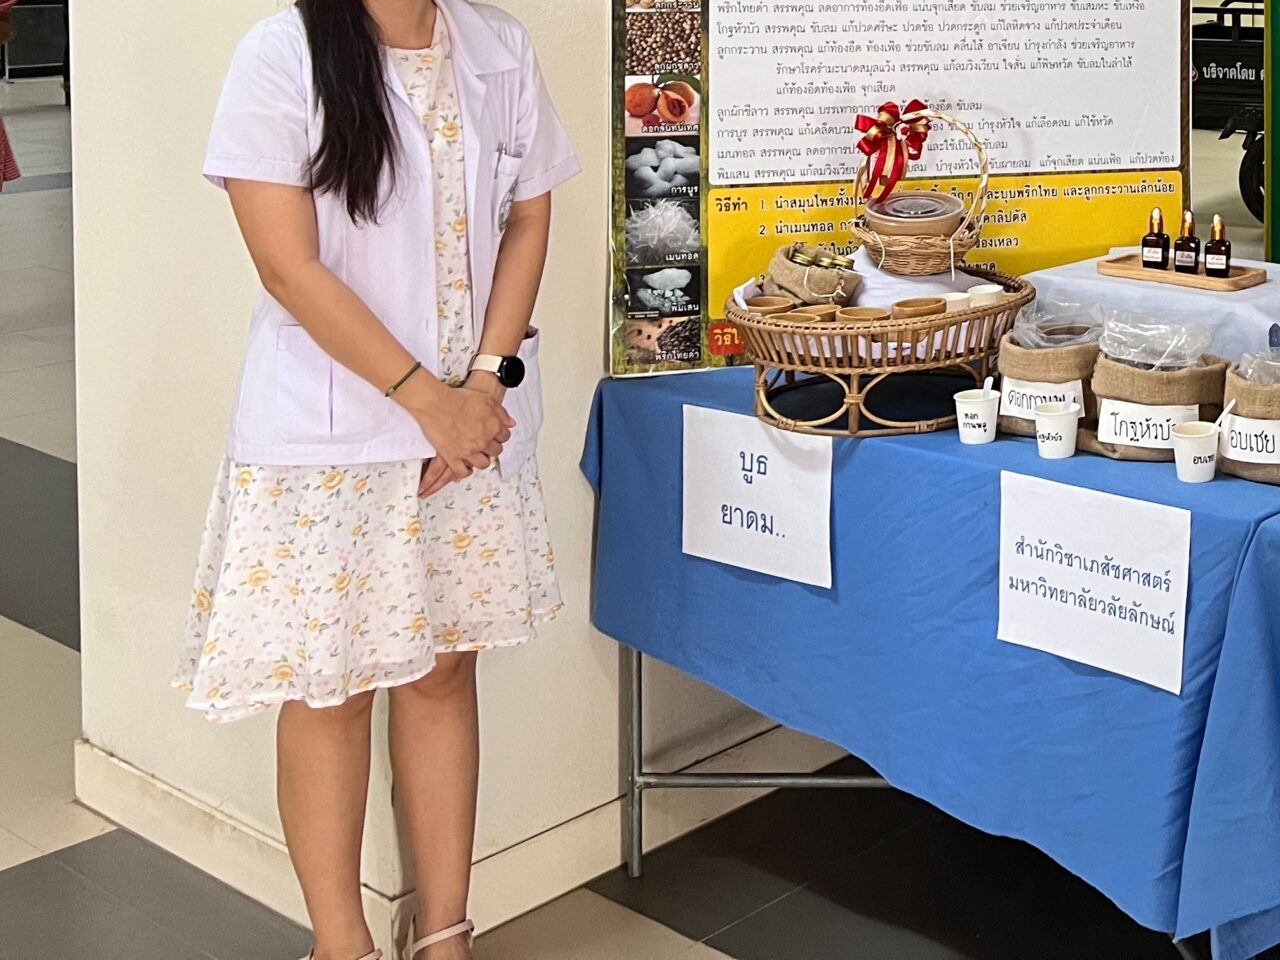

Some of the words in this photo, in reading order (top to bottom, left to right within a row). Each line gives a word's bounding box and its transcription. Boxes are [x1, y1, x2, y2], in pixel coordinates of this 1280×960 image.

[717, 1, 769, 13] พริกไทยดำ
[773, 4, 813, 16] สรรพคุณ
[912, 0, 966, 15] แน่นจุกเสียด
[971, 0, 995, 11] ขับลม
[1000, 0, 1066, 13] ช่วยเจริญอาหาร
[717, 22, 760, 37] โกฐหัวบัว
[765, 24, 805, 37] สรรพคุณ
[811, 22, 837, 32] ขับลม
[903, 20, 932, 32] ปวดข้อ
[939, 21, 986, 35] ปวดกระดูก
[991, 19, 1041, 31] แก้โลหิตจาง
[1045, 18, 1122, 31] แก้ปวดประจำเดือน
[717, 45, 767, 59] ลูกกระวาน
[772, 44, 813, 57] สรรพคุณ
[818, 41, 861, 53] แก้ท้องอืด
[866, 41, 901, 52] ท้องเฟ้อ
[906, 39, 949, 52] ช่วยขับลม
[954, 39, 983, 51] คลื่นไส้
[988, 39, 1019, 50] อาเจียน
[1025, 39, 1067, 54] บำรุงกำลัง
[1071, 38, 1135, 50] ช่วยเจริญอาหาร
[900, 62, 938, 72] สรรพคุณ
[943, 60, 999, 71] แก้ลมวิงเวียน
[1003, 55, 1025, 70] ใจสั่น
[1077, 56, 1132, 69] ขับลมในลำไส้
[1203, 62, 1255, 80] บริจาคโดย
[776, 82, 856, 95] แก้ท้องอืดท้องเฟ้อ
[860, 81, 895, 97] จุกเสียด
[717, 104, 768, 121] ลูกผักชีลาว
[774, 105, 814, 119] สรรพคุณ
[957, 100, 982, 111] ขับลม
[717, 127, 747, 142] การบูร
[753, 127, 793, 140] สรรพคุณ
[978, 118, 1021, 134] บำรุงหัวใจ
[1075, 115, 1113, 127] แก้ไข้หวัด
[717, 149, 755, 159] เมนทอล
[761, 146, 801, 160] สรรพคุณ
[717, 168, 749, 179] พิมเสน
[754, 167, 795, 180] สรรพคุณ
[1040, 154, 1084, 170] แก้จุกเสียด
[1088, 155, 1121, 166] แน่นเฟ้อ
[1130, 151, 1174, 165] แก้ปวดท้อง
[671, 185, 698, 196] การบูร
[716, 197, 748, 212] วิธีทำ
[1063, 179, 1174, 200] และลูกกระวานเล็กน้อย
[775, 221, 834, 234] นำเมนทอล
[666, 252, 698, 261] เมนทอล
[1111, 412, 1176, 441] โกฐหัวบั
[1231, 429, 1275, 453] อบเชย
[739, 448, 768, 484] บูธ
[721, 501, 787, 538] ยาดม..
[1015, 537, 1172, 594] สำนักวิชาเภสัชศาสตร์
[1008, 573, 1175, 636] มหาวิทยาลัยวลัยลักษณ์
